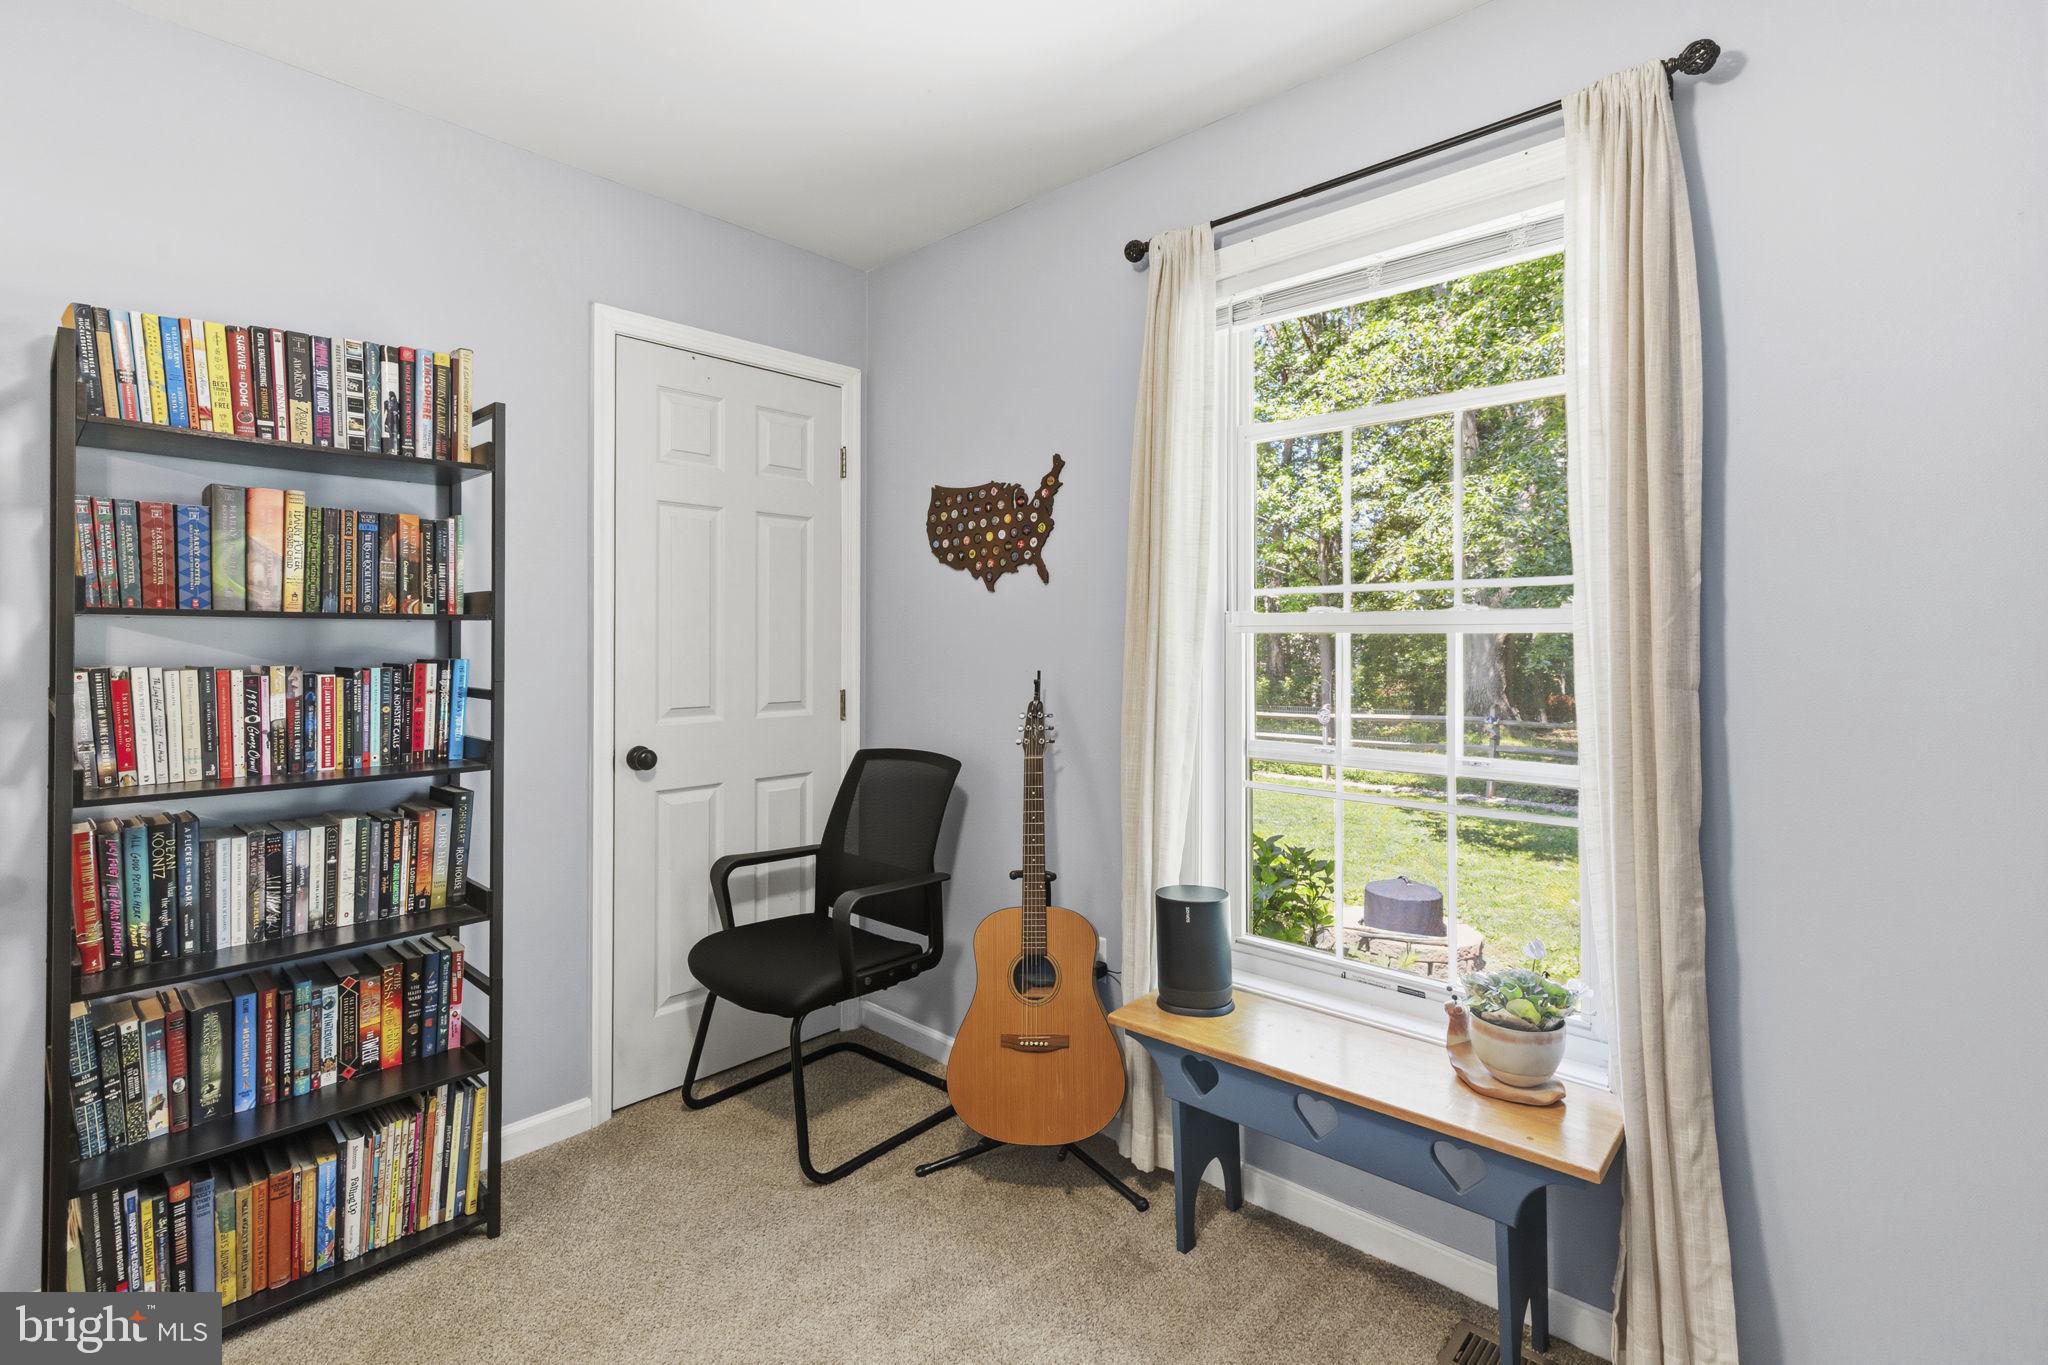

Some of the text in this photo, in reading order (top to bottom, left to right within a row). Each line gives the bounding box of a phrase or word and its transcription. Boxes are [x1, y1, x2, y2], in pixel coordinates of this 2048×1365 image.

[236, 335, 249, 407] SURVIVE DOME
[257, 333, 269, 418] CIVIL ENGINEERING FORMULAS
[293, 358, 303, 398] AWAKENING
[316, 370, 328, 390] SPIRIT
[423, 356, 431, 420] ATMOSPHERE
[316, 391, 329, 413] GUIDES
[297, 407, 308, 436] ZODIAC
[83, 523, 95, 574] HARRY POTTER
[293, 510, 304, 571] HARRY POTTER
[362, 543, 372, 551] LIES
[106, 551, 114, 575] POTTER
[424, 563, 433, 598] Mockingbird
[98, 719, 109, 737] NAME
[246, 689, 260, 773] 1984 George Orwell
[457, 804, 467, 843] JOHN HART
[79, 841, 91, 852] THE
[105, 840, 120, 878] LUCY FOLEY
[152, 832, 165, 880] KOONTZ
[165, 840, 176, 870] DEAN
[184, 834, 192, 866] FLICKER
[420, 821, 431, 871] JOHN HART
[437, 824, 447, 876] JOHN HART
[81, 864, 95, 884] VINCI
[130, 834, 143, 918] ALL GOOD PEOPLE HERE
[454, 847, 464, 889] IRON HOUSE
[82, 885, 95, 903] CODE
[184, 885, 192, 907] DARK
[106, 883, 124, 956] THE PARIS APARTMENT
[383, 968, 394, 1025] PASSAGE
[242, 1027, 250, 1078] MOCKINGJAY
[361, 1037, 379, 1065] TWELVE
[348, 1177, 359, 1215] Falling Up
[114, 1226, 122, 1250] FITNESS
[174, 1202, 187, 1265] THE GHOSTWRITER
[116, 1251, 124, 1281] PROGRAM
[130, 1247, 138, 1259] THE
[131, 1260, 140, 1289] DISABLED
